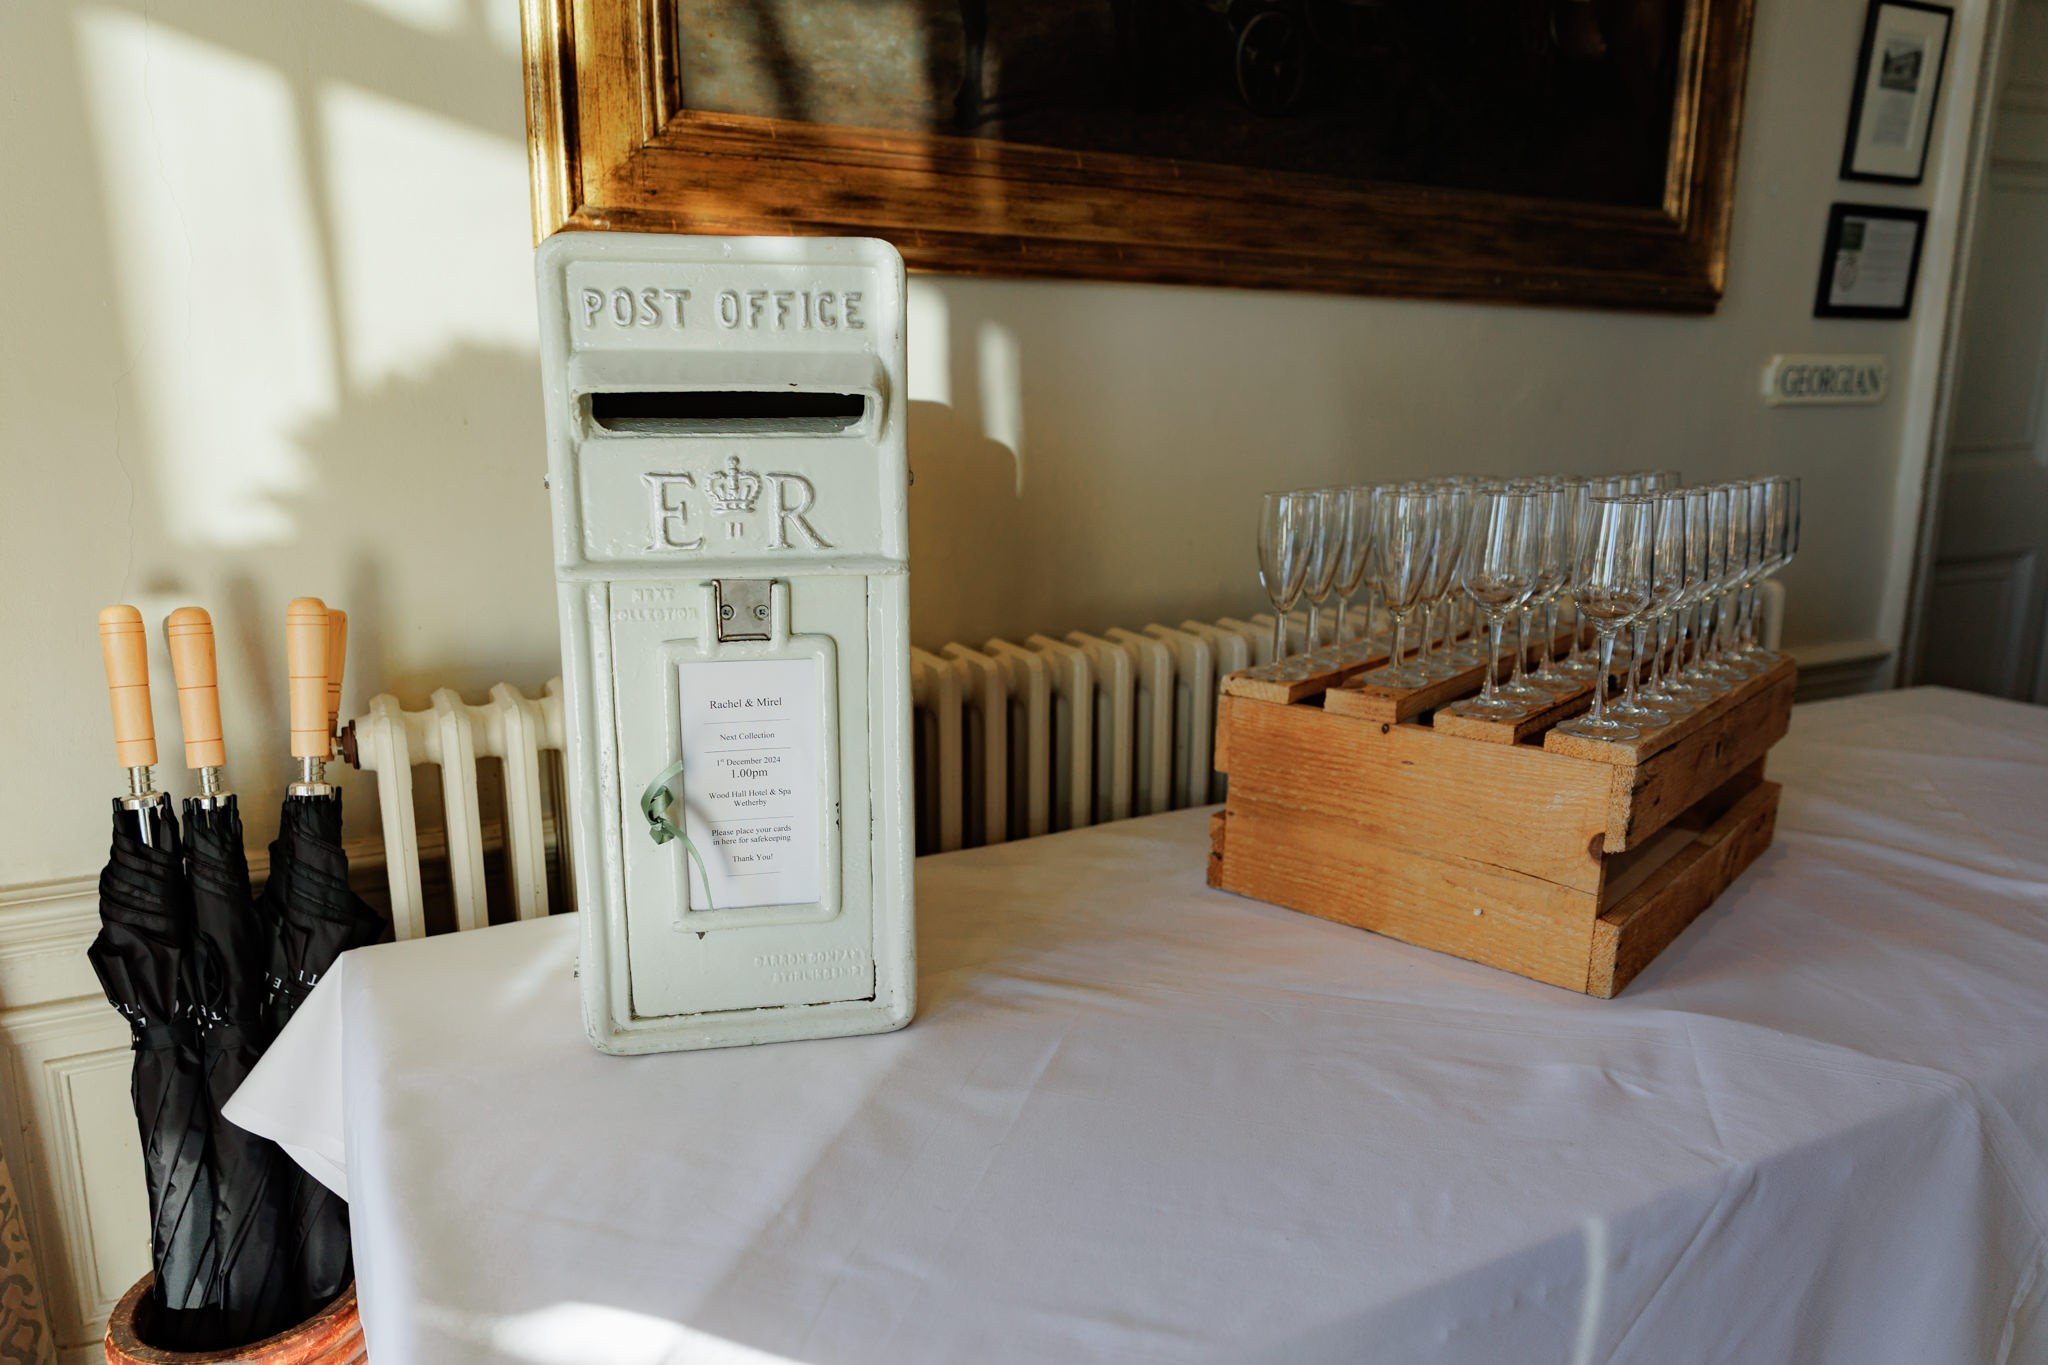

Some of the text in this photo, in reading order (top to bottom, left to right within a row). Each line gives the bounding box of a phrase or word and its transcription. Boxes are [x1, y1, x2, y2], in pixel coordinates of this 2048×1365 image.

[582, 287, 864, 330] POST OFFICE
[1780, 365, 1880, 398] GEORGIAN
[640, 471, 834, 551] E R
[710, 697, 782, 710] Rachel & Mirel
[738, 731, 775, 740] Collection
[726, 757, 763, 766] December
[763, 756, 781, 764] 2024
[731, 768, 768, 780] 1.00pm
[709, 792, 730, 800] Wood
[748, 789, 768, 797] Hotel
[778, 788, 792, 796] Spa
[734, 799, 767, 808] Wetherby
[711, 825, 792, 837] Please place your cards
[713, 834, 792, 846] in here for safekeeping
[732, 853, 774, 863] Thank You!
